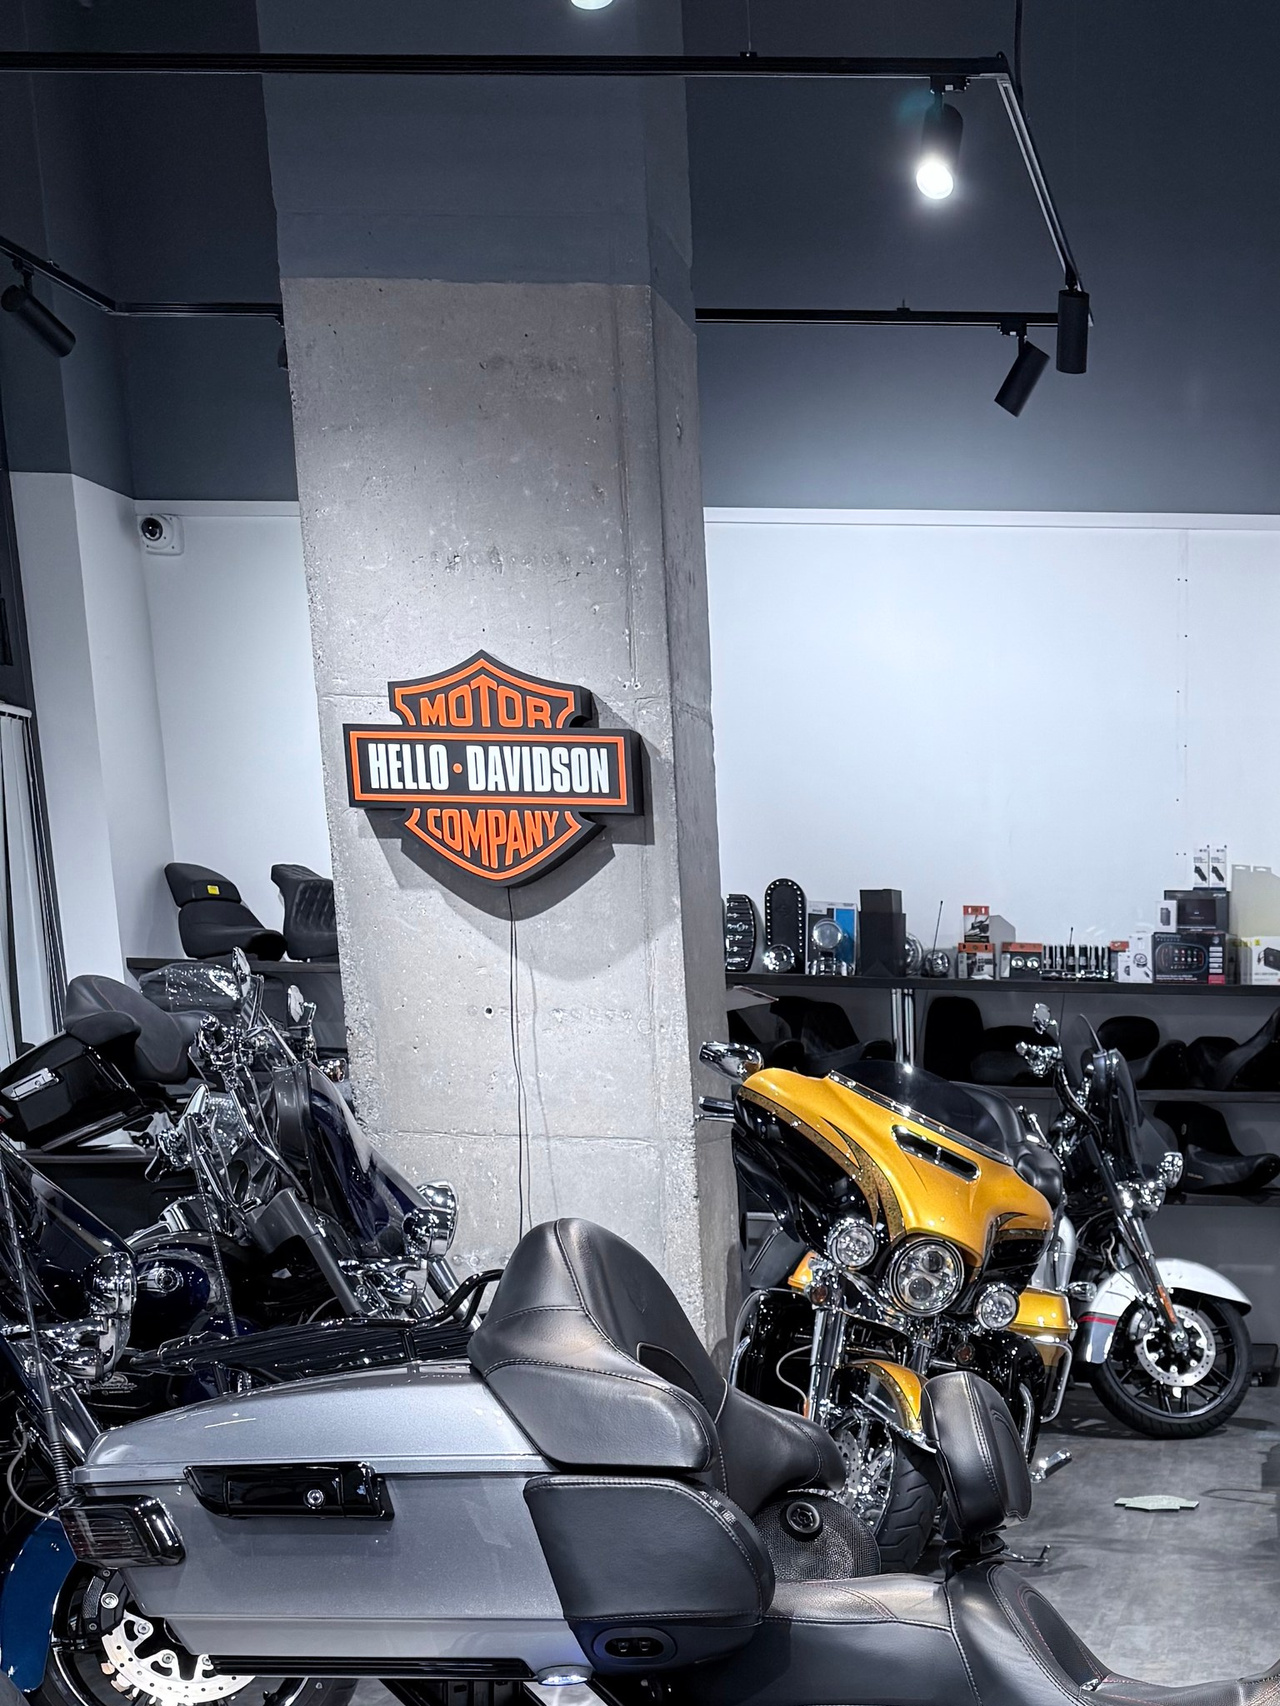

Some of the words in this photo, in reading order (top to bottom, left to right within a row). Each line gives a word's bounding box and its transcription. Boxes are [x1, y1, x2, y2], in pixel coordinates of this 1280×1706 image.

[420, 675, 551, 728] MOTOR
[368, 743, 449, 791] HELLO
[466, 745, 609, 793] DAVIDSON
[427, 808, 559, 869] COMPANY
